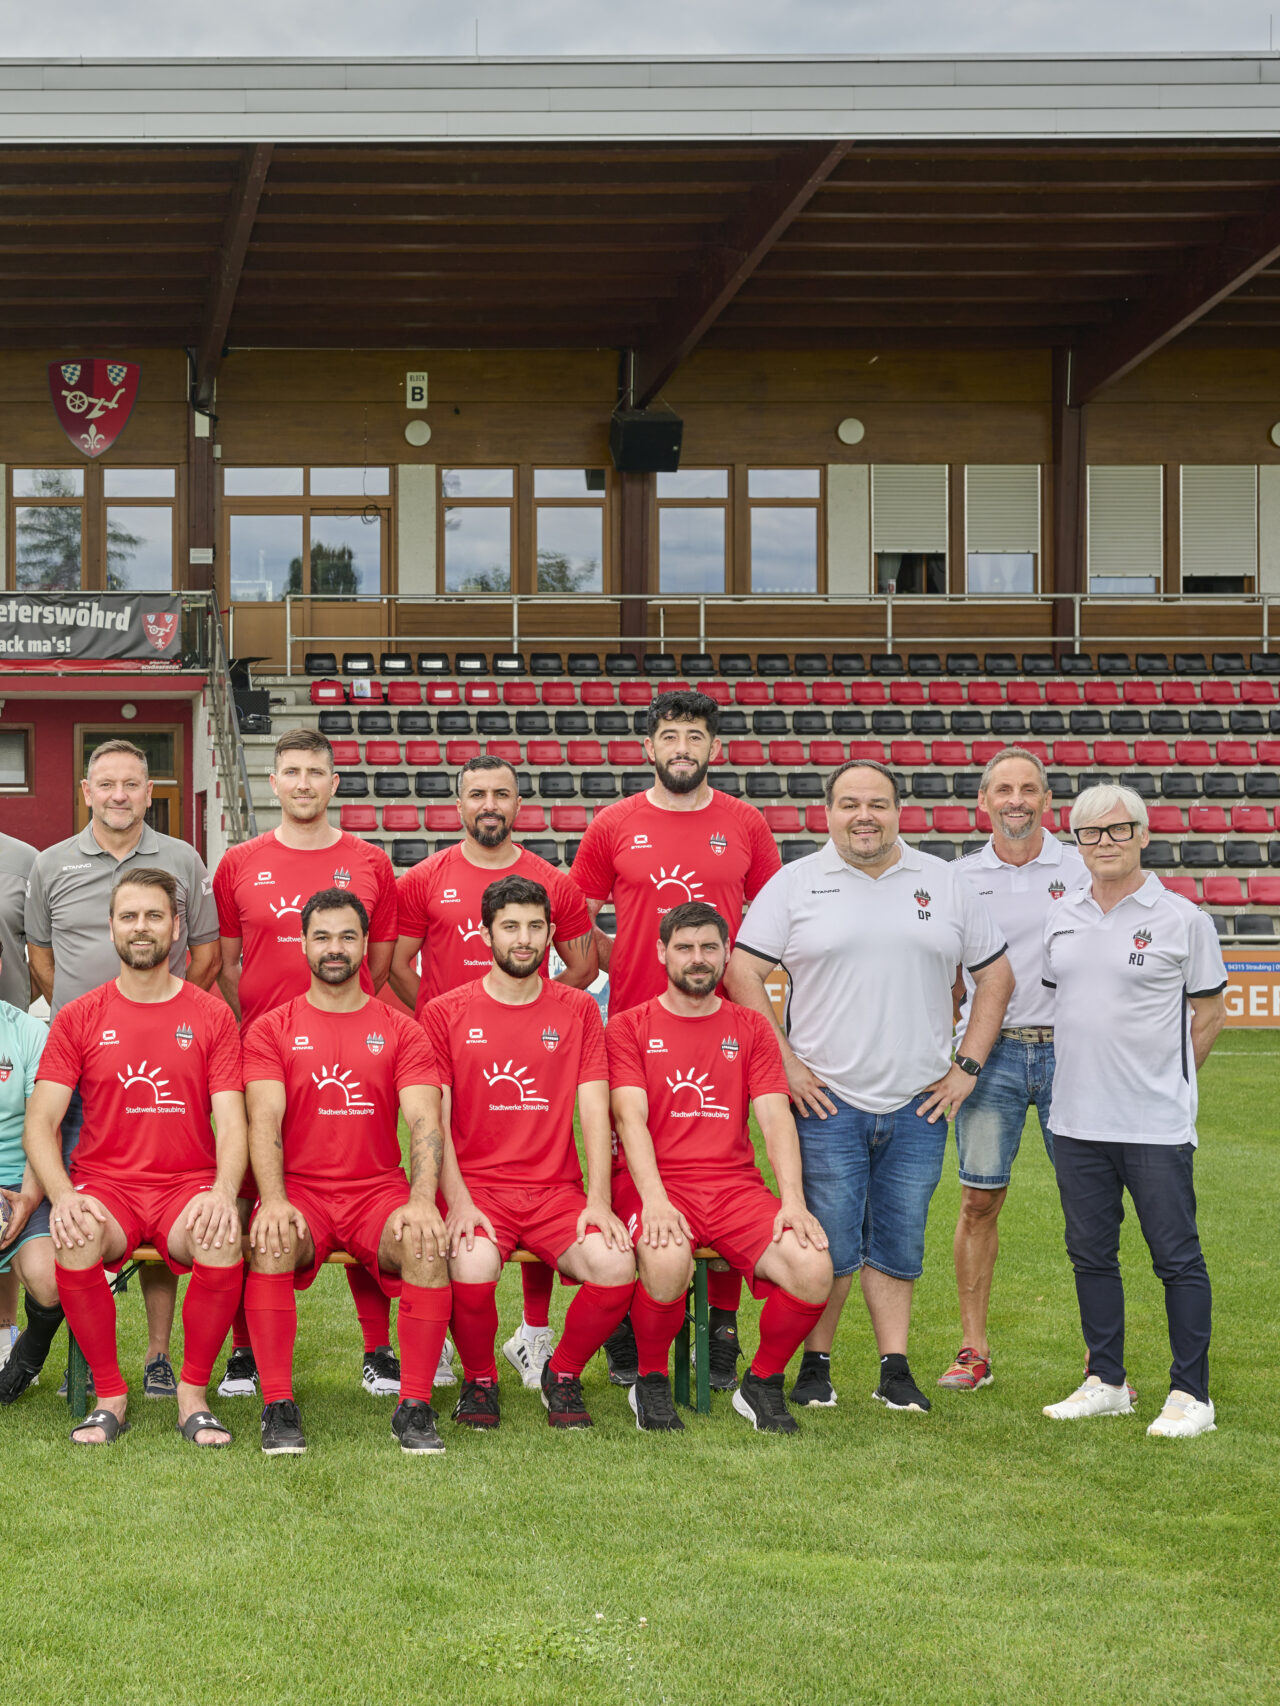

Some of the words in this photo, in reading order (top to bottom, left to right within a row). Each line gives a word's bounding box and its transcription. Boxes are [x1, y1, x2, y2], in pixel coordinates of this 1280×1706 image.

[411, 386, 424, 402] B
[28, 636, 71, 653] ma's!
[62, 863, 92, 871] STANNO
[277, 935, 301, 943] Stadtwe
[1128, 953, 1144, 966] RD
[1246, 963, 1272, 972] Straubing
[125, 1105, 156, 1114] Stadtwerke
[157, 1105, 186, 1115] Straubing
[318, 1107, 347, 1116] Stadtwerke
[348, 1107, 374, 1116] Straubing
[489, 1103, 521, 1111] Stadtwerke
[522, 1103, 549, 1112] Straubing
[701, 1111, 730, 1120] Straubing
